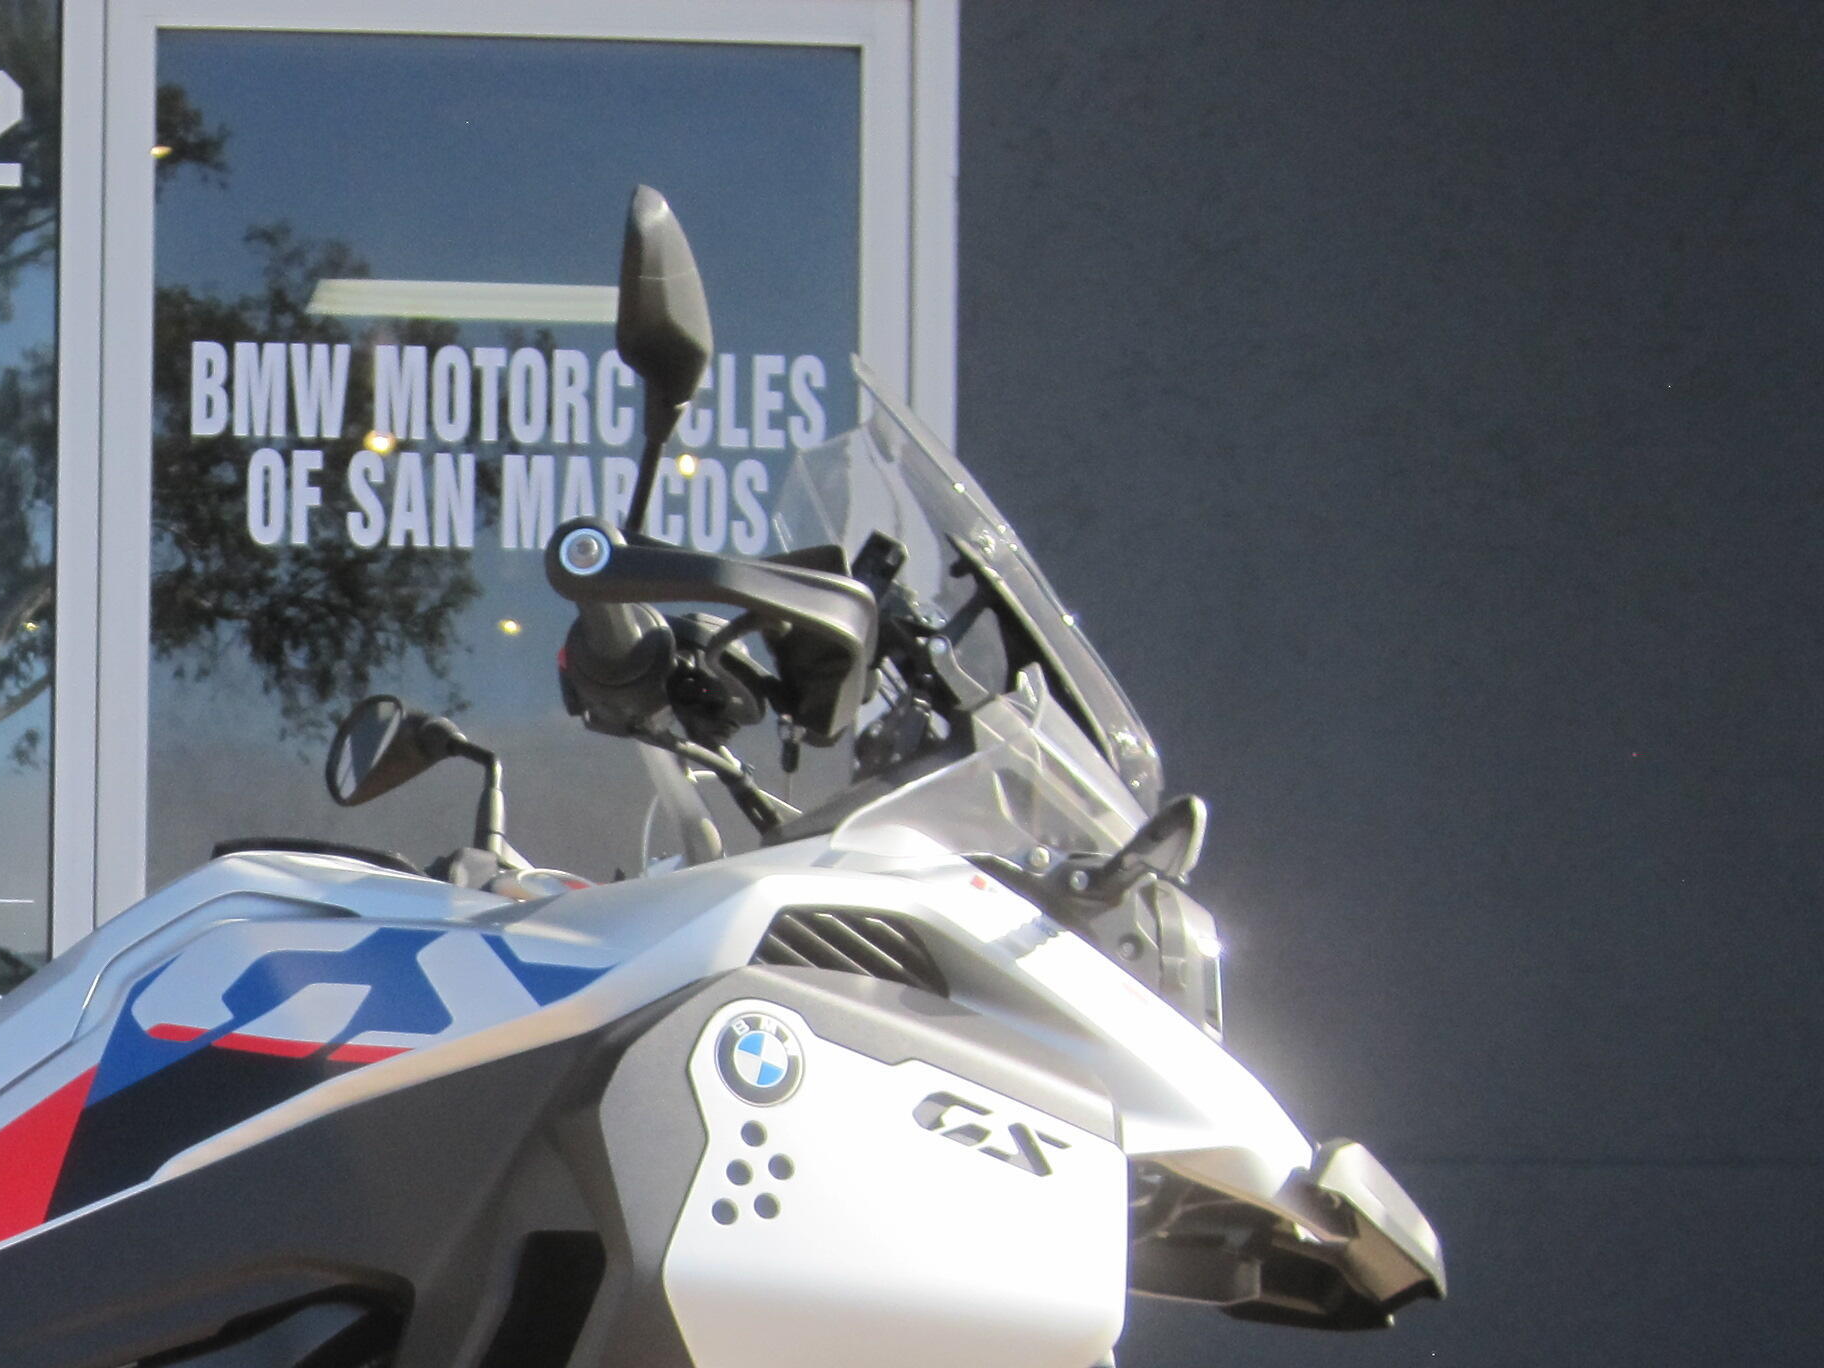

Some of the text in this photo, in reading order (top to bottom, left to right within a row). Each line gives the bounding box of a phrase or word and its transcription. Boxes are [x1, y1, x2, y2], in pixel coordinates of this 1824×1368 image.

[190, 340, 827, 450] BMW MOTORCCLES
[246, 447, 769, 557] OF SAN MARCOS
